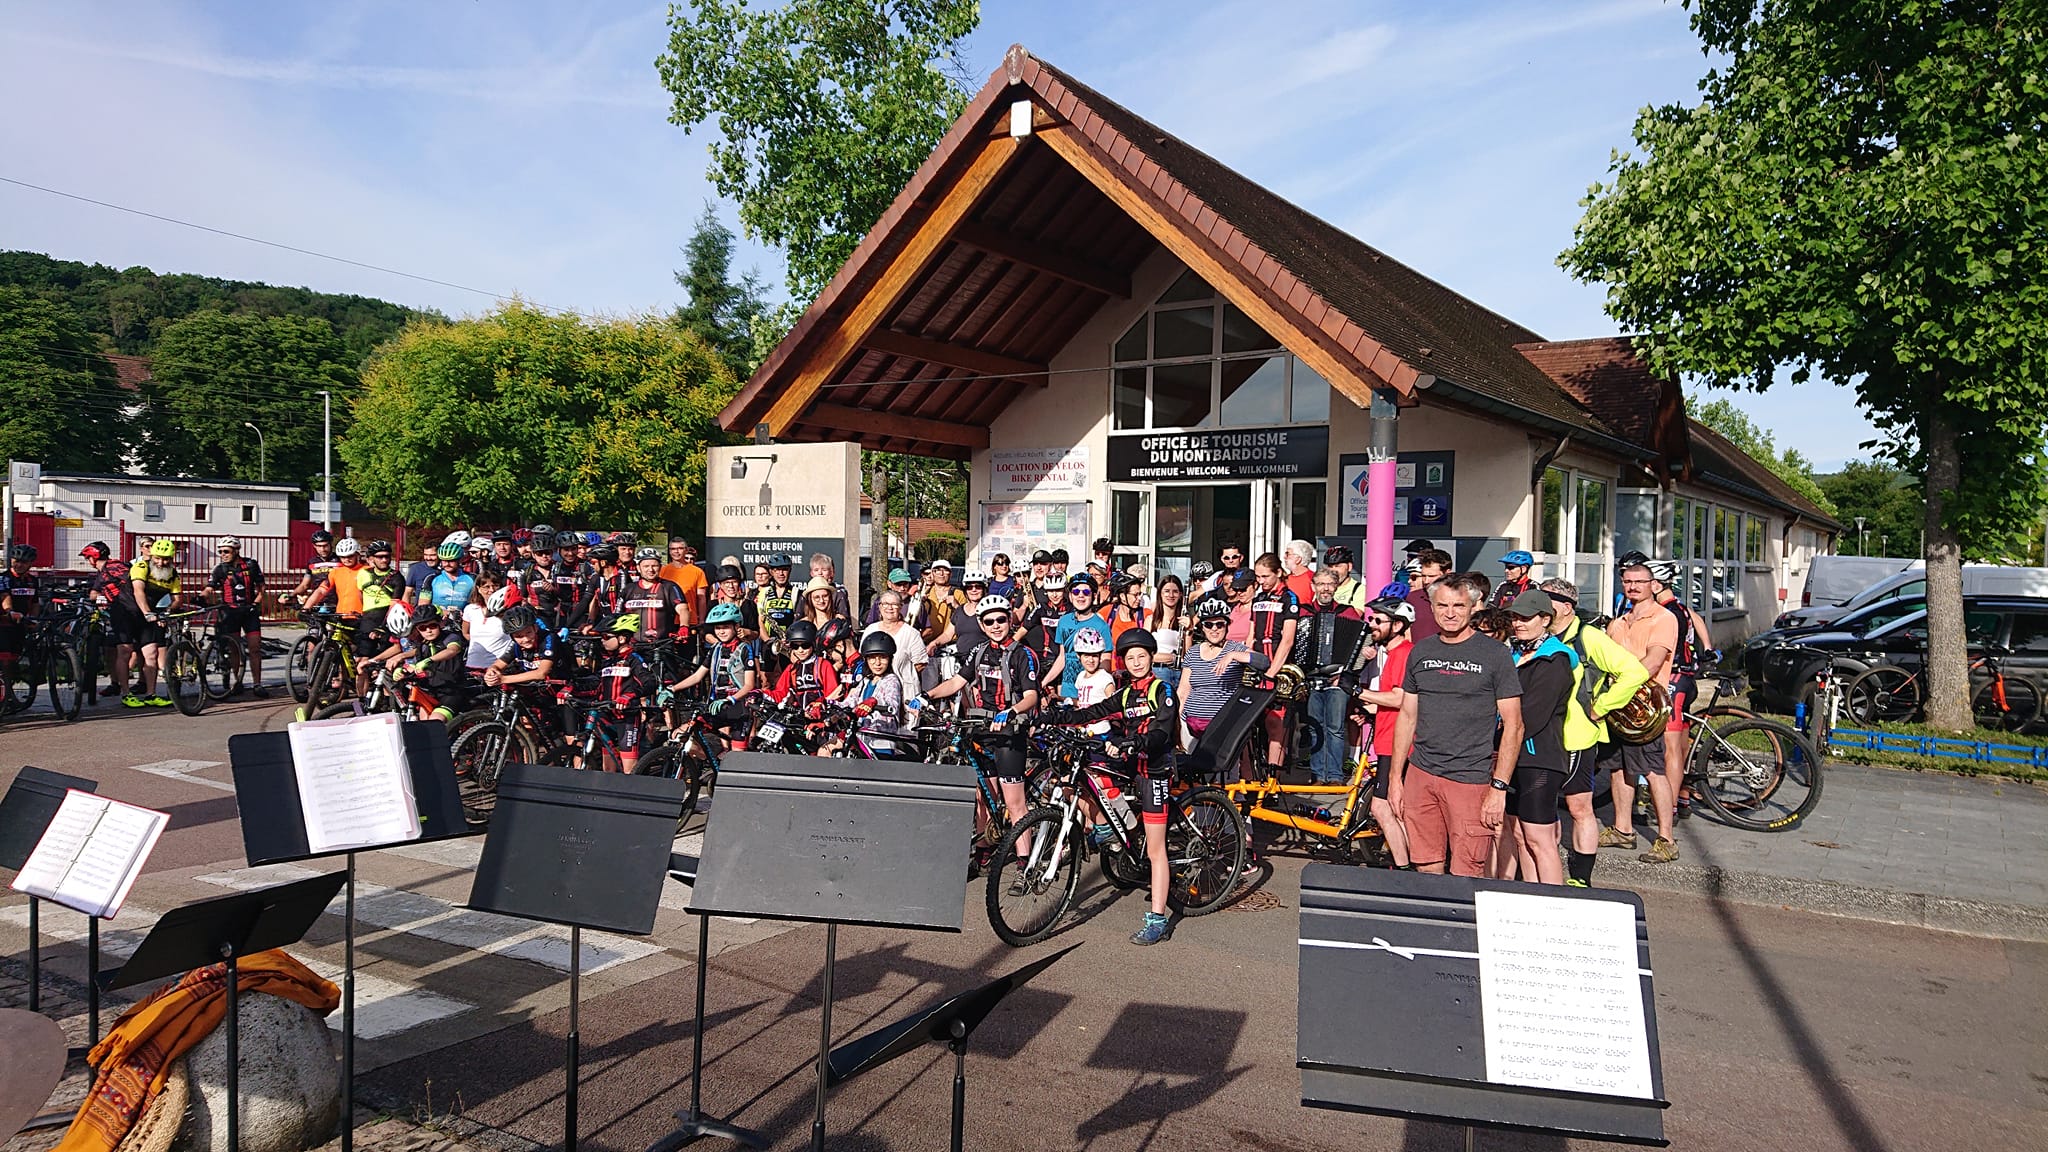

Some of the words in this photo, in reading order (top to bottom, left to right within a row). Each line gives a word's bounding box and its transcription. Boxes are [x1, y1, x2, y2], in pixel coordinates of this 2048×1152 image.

[1141, 436, 1188, 450] OFFICE
[1191, 435, 1209, 449] DE
[1211, 432, 1288, 447] TOURISME
[1150, 450, 1169, 464] DU
[1172, 447, 1277, 463] MONTBARDOIS
[996, 463, 1040, 472] LOCATION
[1042, 462, 1054, 471] DE
[1055, 461, 1085, 470] VELOS
[1130, 467, 1179, 477] BIENVENUE
[1186, 466, 1231, 476] WELCOME
[1239, 463, 1299, 474] WILKOMMEN
[1011, 474, 1032, 483] BIKE
[1034, 473, 1069, 482] RENTAL
[722, 505, 756, 517] OFFICE
[759, 505, 772, 517] DE
[775, 504, 827, 516] TOURISME
[743, 540, 760, 551] CITÉ
[760, 542, 771, 551] DE
[772, 542, 803, 551] BUFFON
[743, 554, 754, 563] EN
[761, 727, 778, 739] 213
